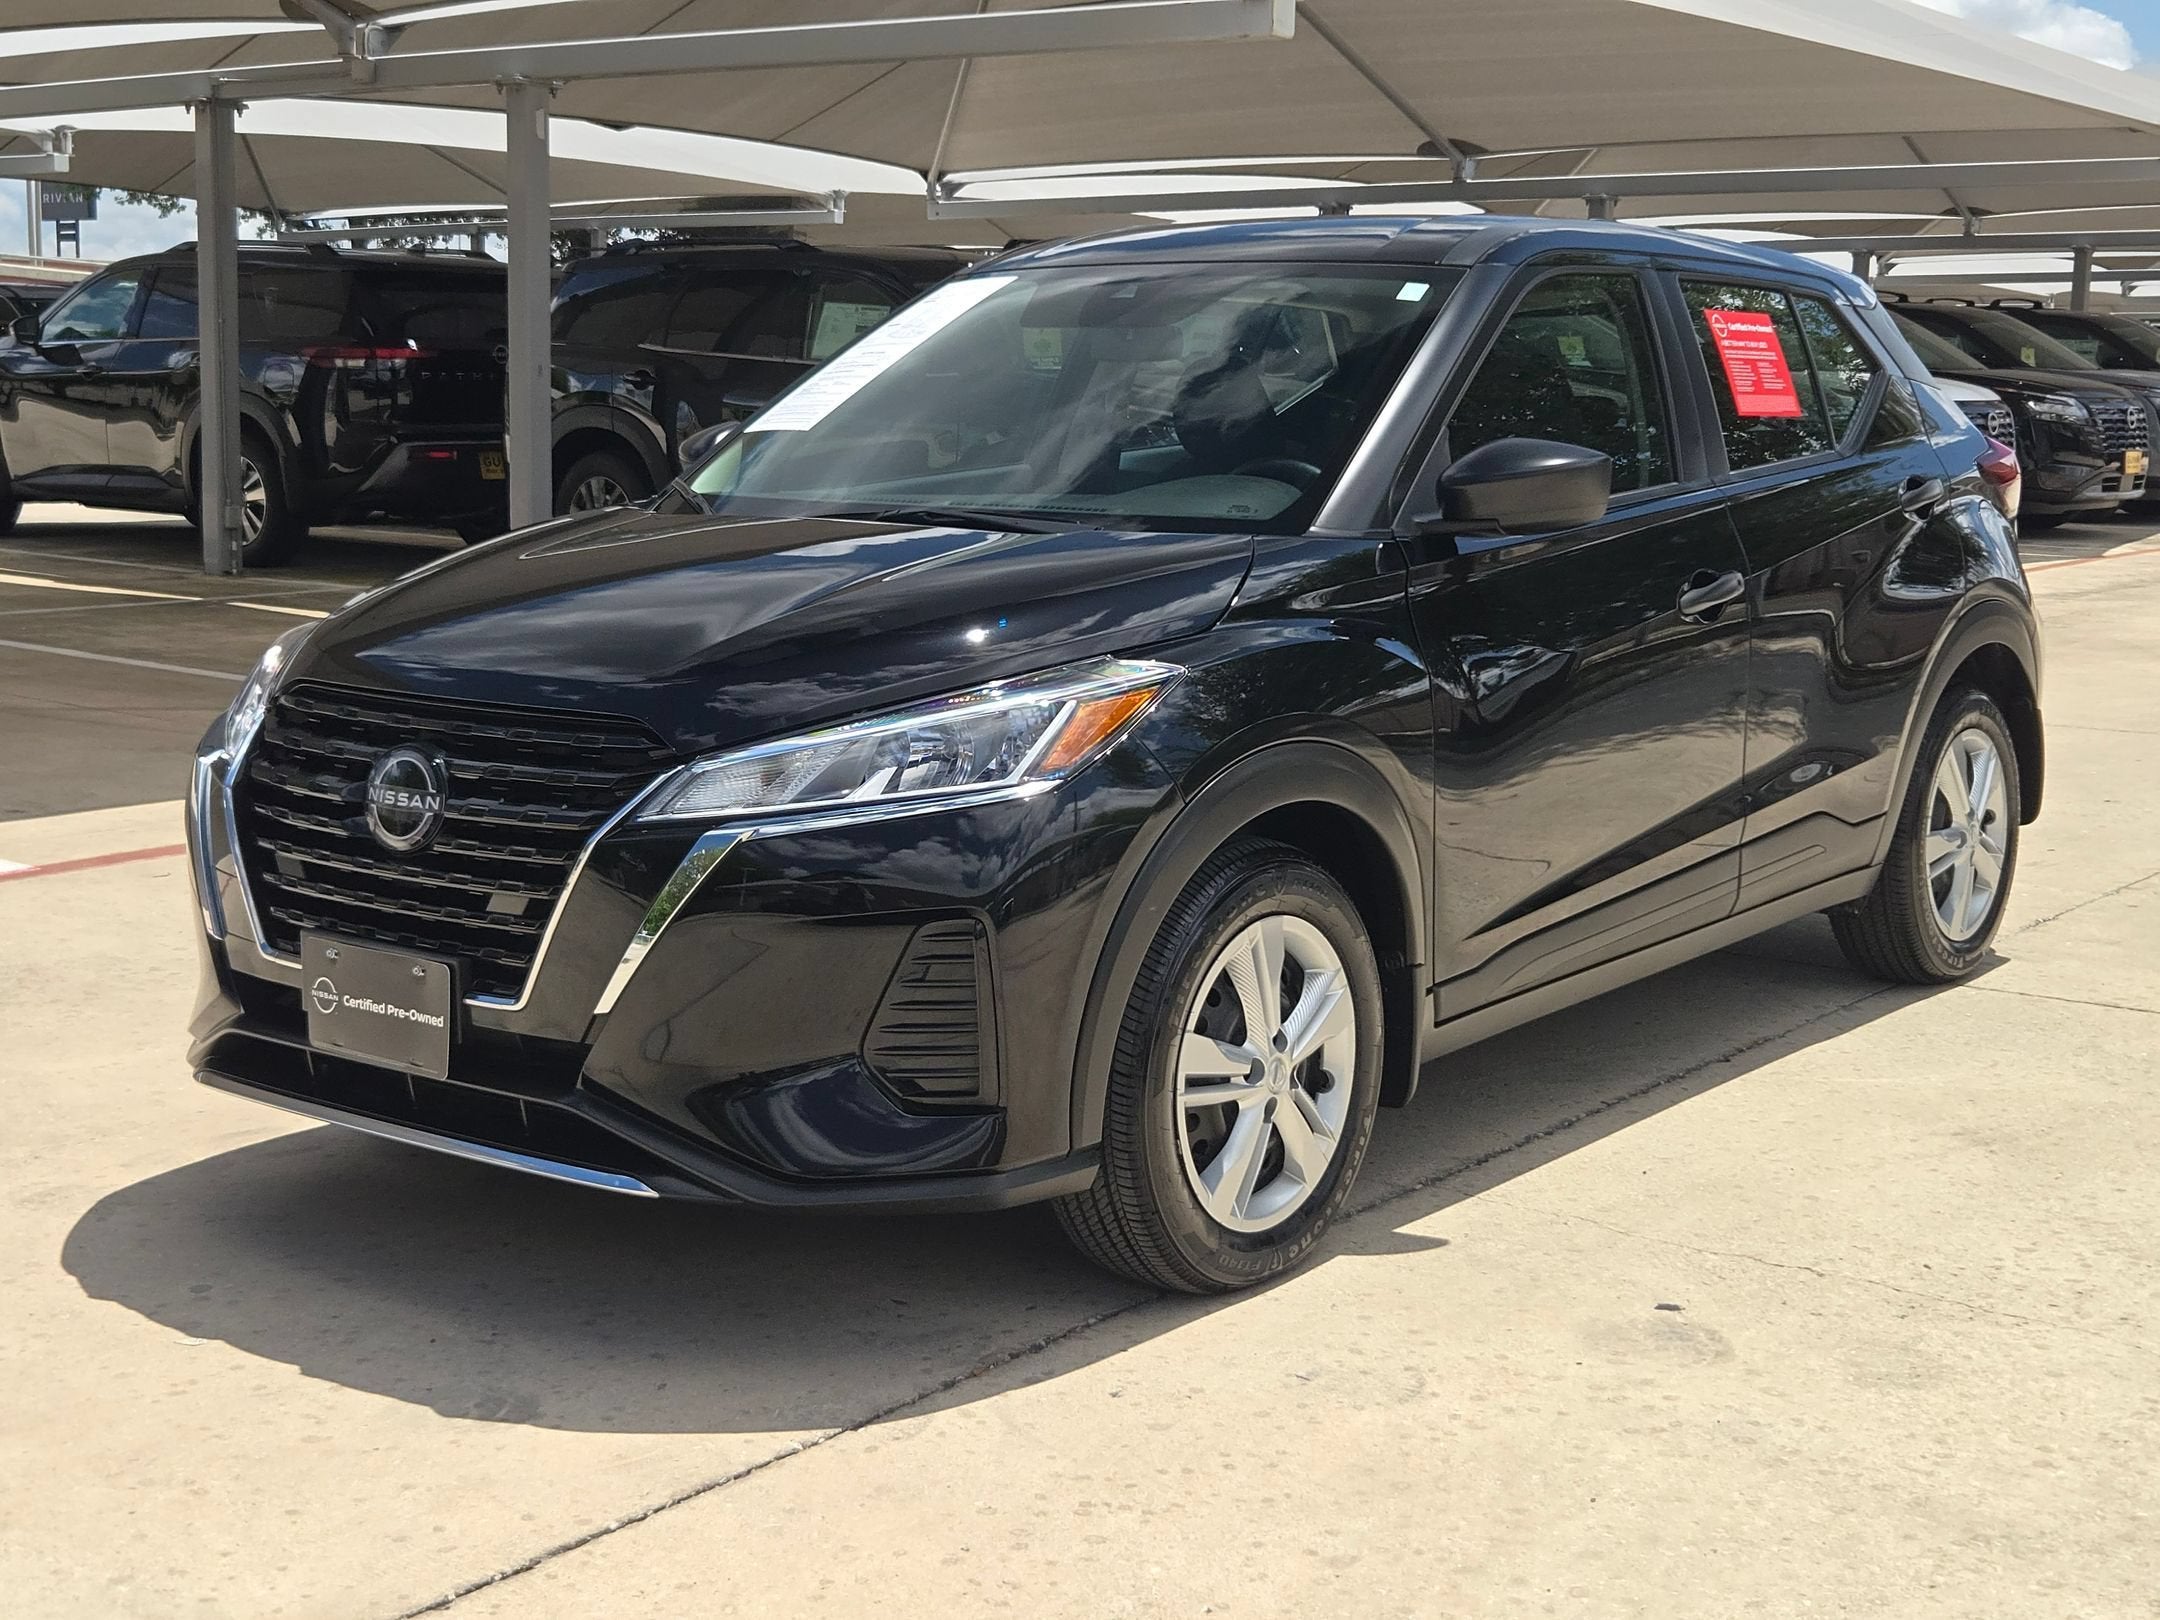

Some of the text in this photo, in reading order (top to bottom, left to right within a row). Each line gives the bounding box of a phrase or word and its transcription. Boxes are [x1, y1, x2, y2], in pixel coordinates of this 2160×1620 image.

[368, 787, 440, 810] NISSAN
[311, 989, 339, 1001] NISSAN
[343, 995, 444, 1028] Certified Pre-Owned
